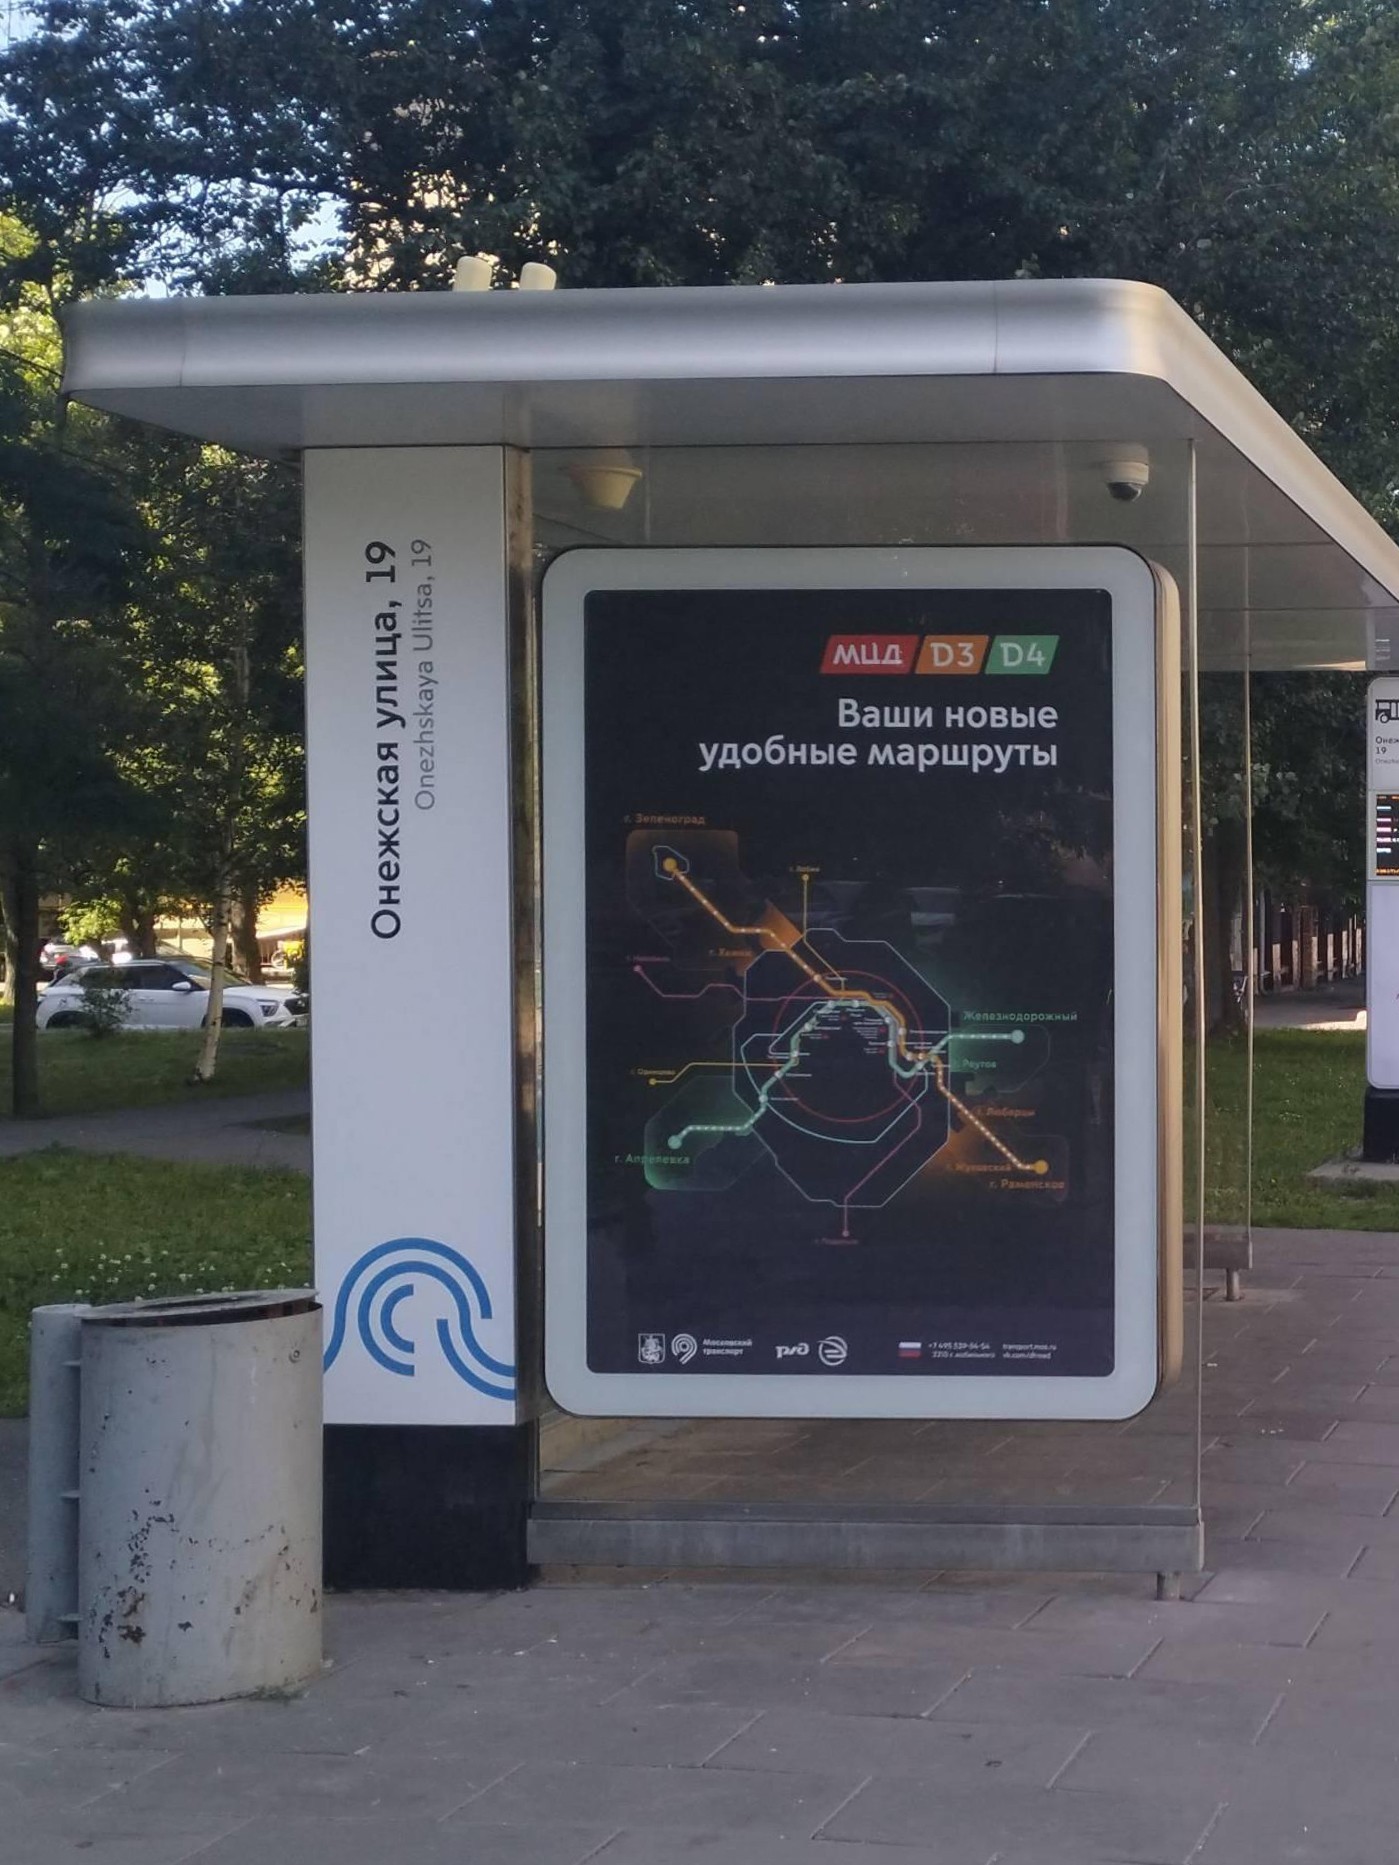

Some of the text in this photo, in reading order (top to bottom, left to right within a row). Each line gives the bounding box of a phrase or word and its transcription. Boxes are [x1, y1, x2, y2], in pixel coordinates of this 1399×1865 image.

[833, 641, 1046, 668] МЦД D3 D4
[410, 538, 439, 811] Onezhskaya Ulitsa, 19
[838, 698, 1059, 729] Ваши новые
[364, 540, 406, 940] Онежская улица, 19
[698, 733, 1058, 773] удобные маршруты
[1375, 746, 1387, 755] 19
[635, 813, 706, 826] Зеленоград
[963, 1010, 1078, 1023] Железнодорожный
